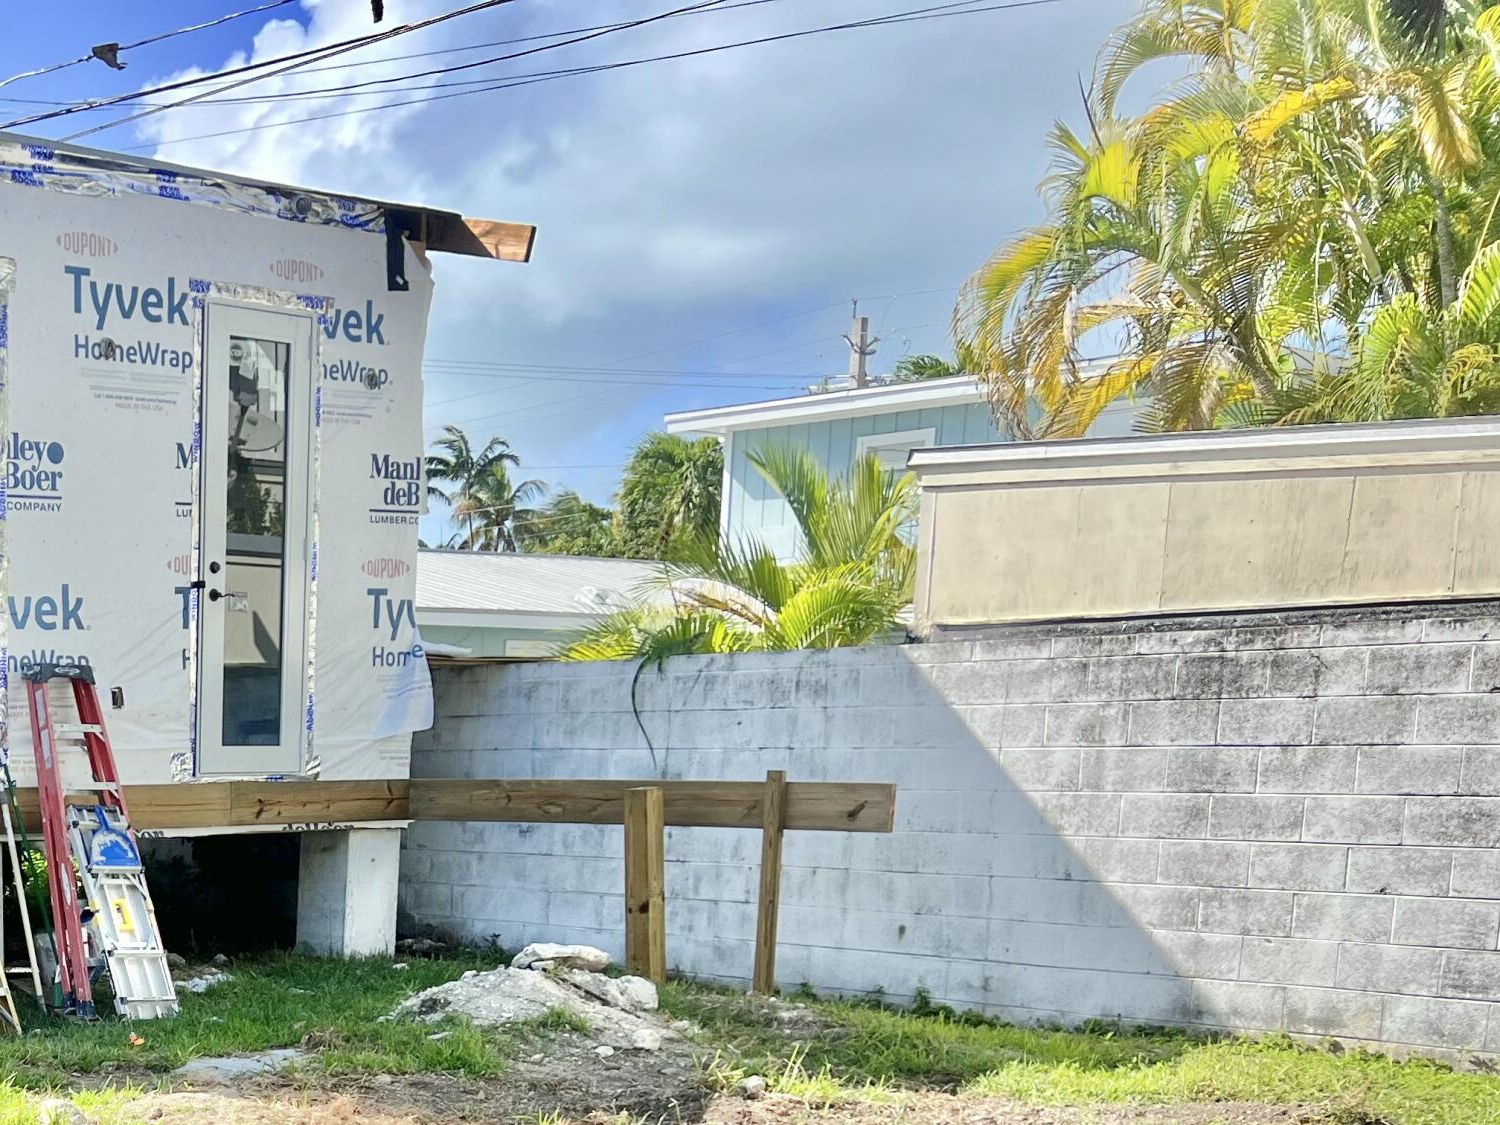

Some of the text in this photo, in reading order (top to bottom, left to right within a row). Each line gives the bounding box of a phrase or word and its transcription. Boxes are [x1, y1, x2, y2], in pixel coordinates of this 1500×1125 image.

[63, 231, 112, 257] DUPONT
[276, 260, 319, 283] DUPONT
[64, 265, 190, 331] Tyvek
[6, 500, 63, 512] COMPANY
[370, 514, 407, 525] LUMBER
[366, 558, 406, 579] DUPONT
